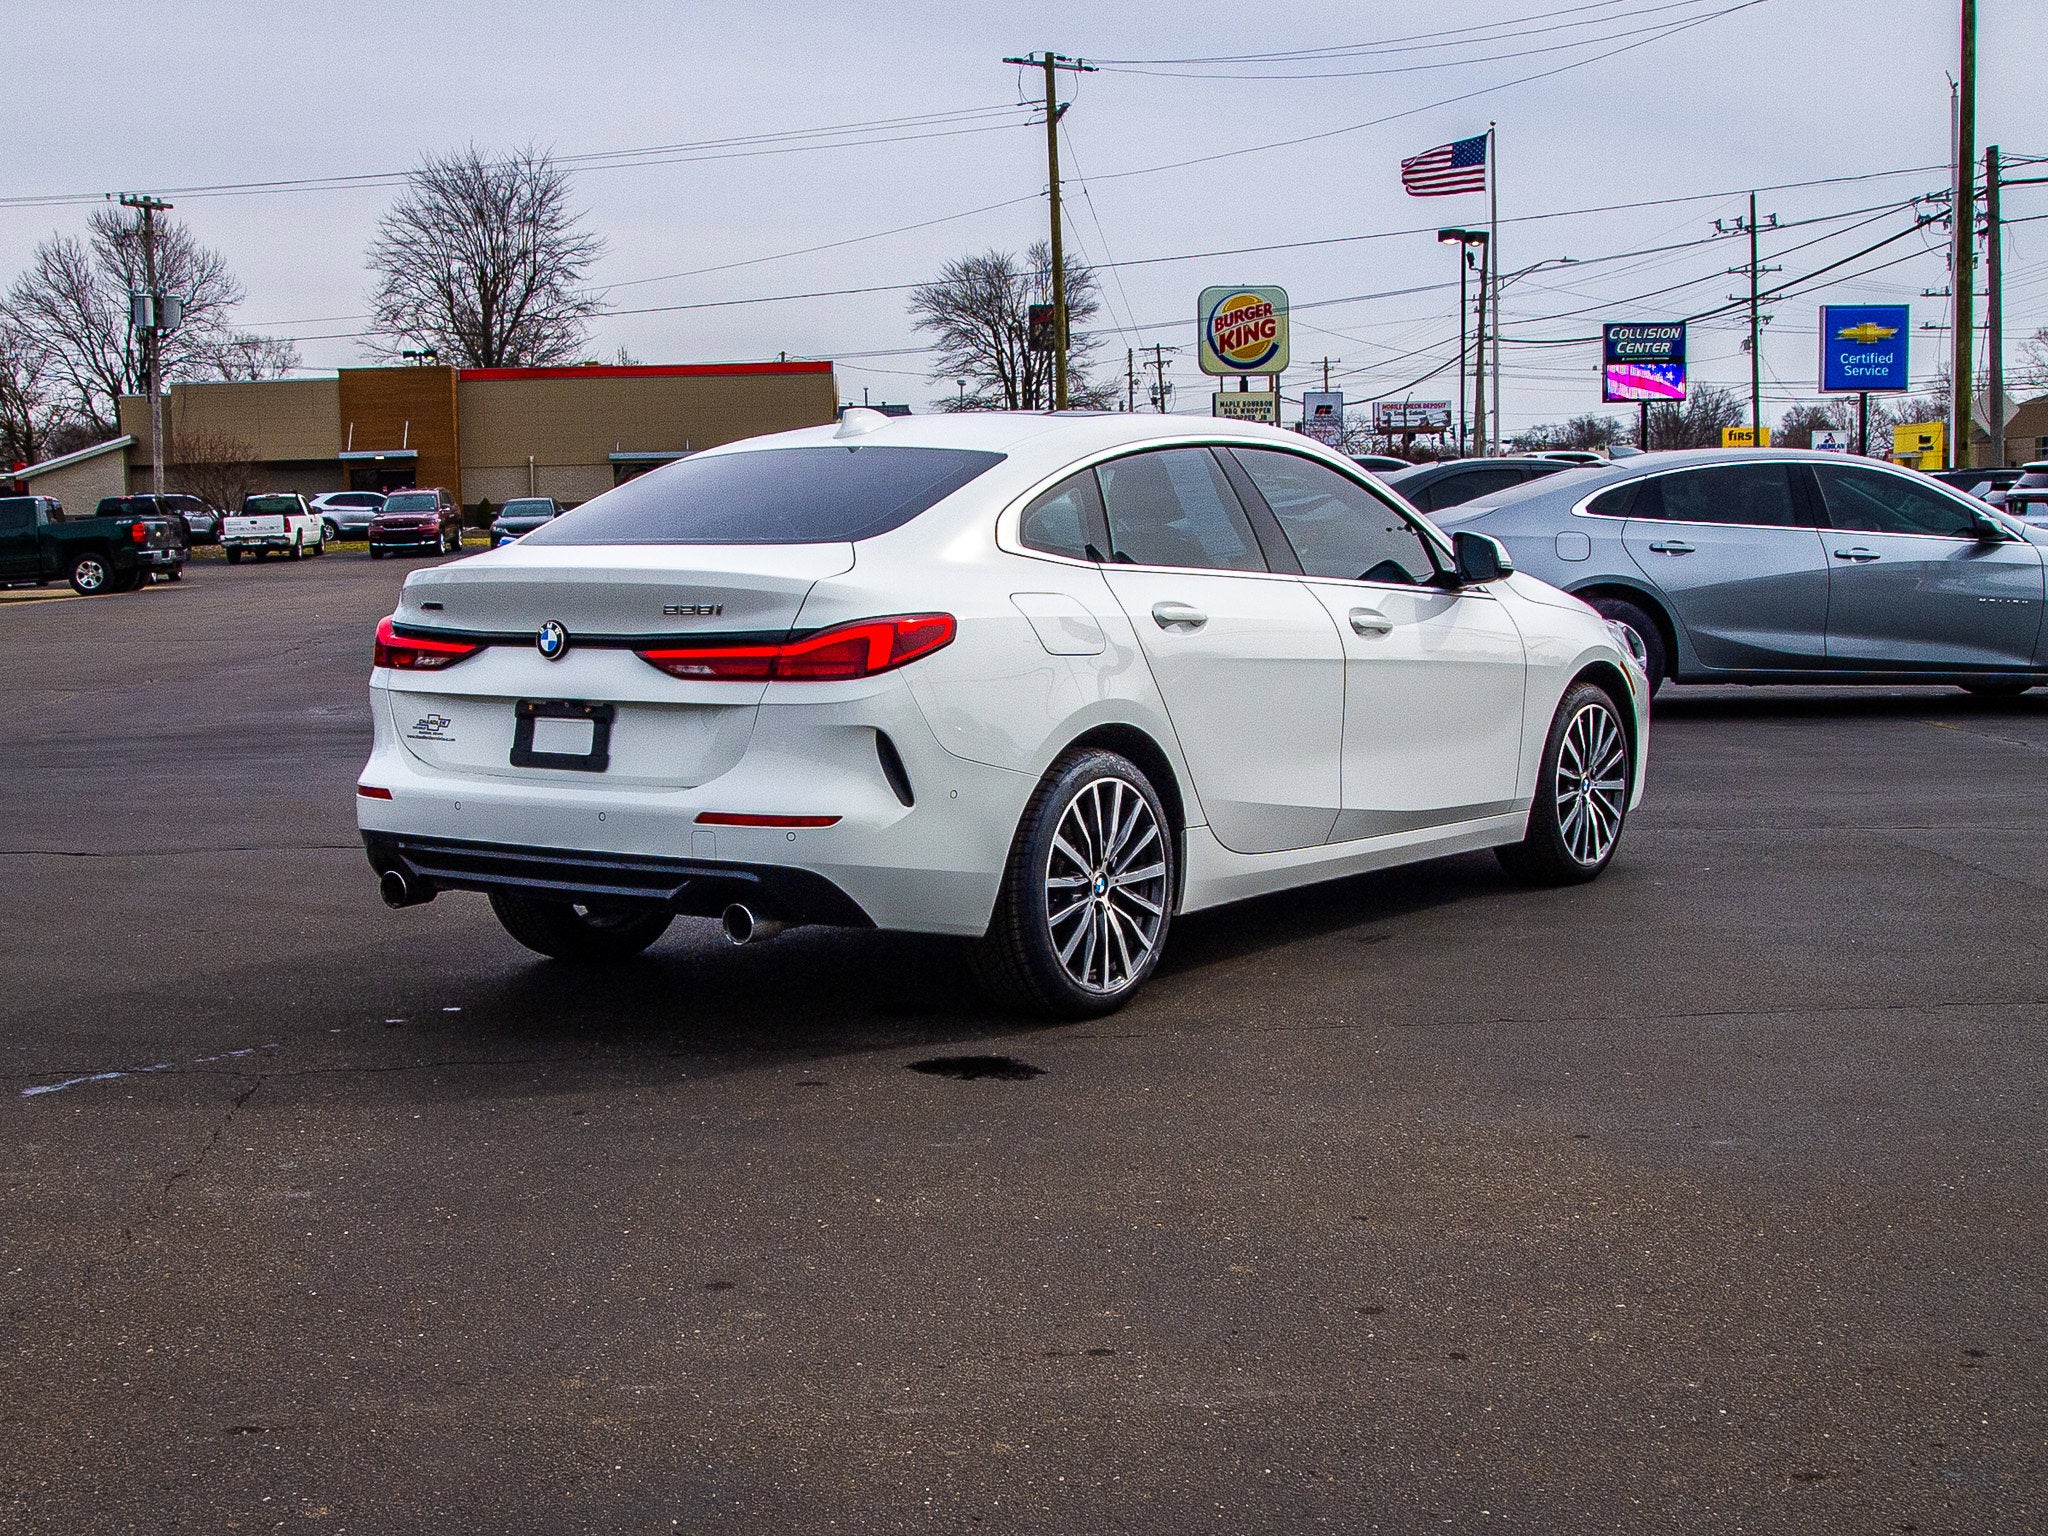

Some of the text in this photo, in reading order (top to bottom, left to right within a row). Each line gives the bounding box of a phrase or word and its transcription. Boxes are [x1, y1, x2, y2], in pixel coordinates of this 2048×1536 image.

[1214, 302, 1273, 333] BURGER
[1218, 318, 1276, 354] KING
[1609, 327, 1681, 339] COLLISION
[1616, 341, 1671, 353] CENTER
[1840, 352, 1894, 364] Certified
[1844, 365, 1889, 376] Service
[1219, 400, 1273, 408] MAPLE BOURBON
[227, 525, 281, 533] CHEVROLET
[663, 604, 723, 616] 228i
